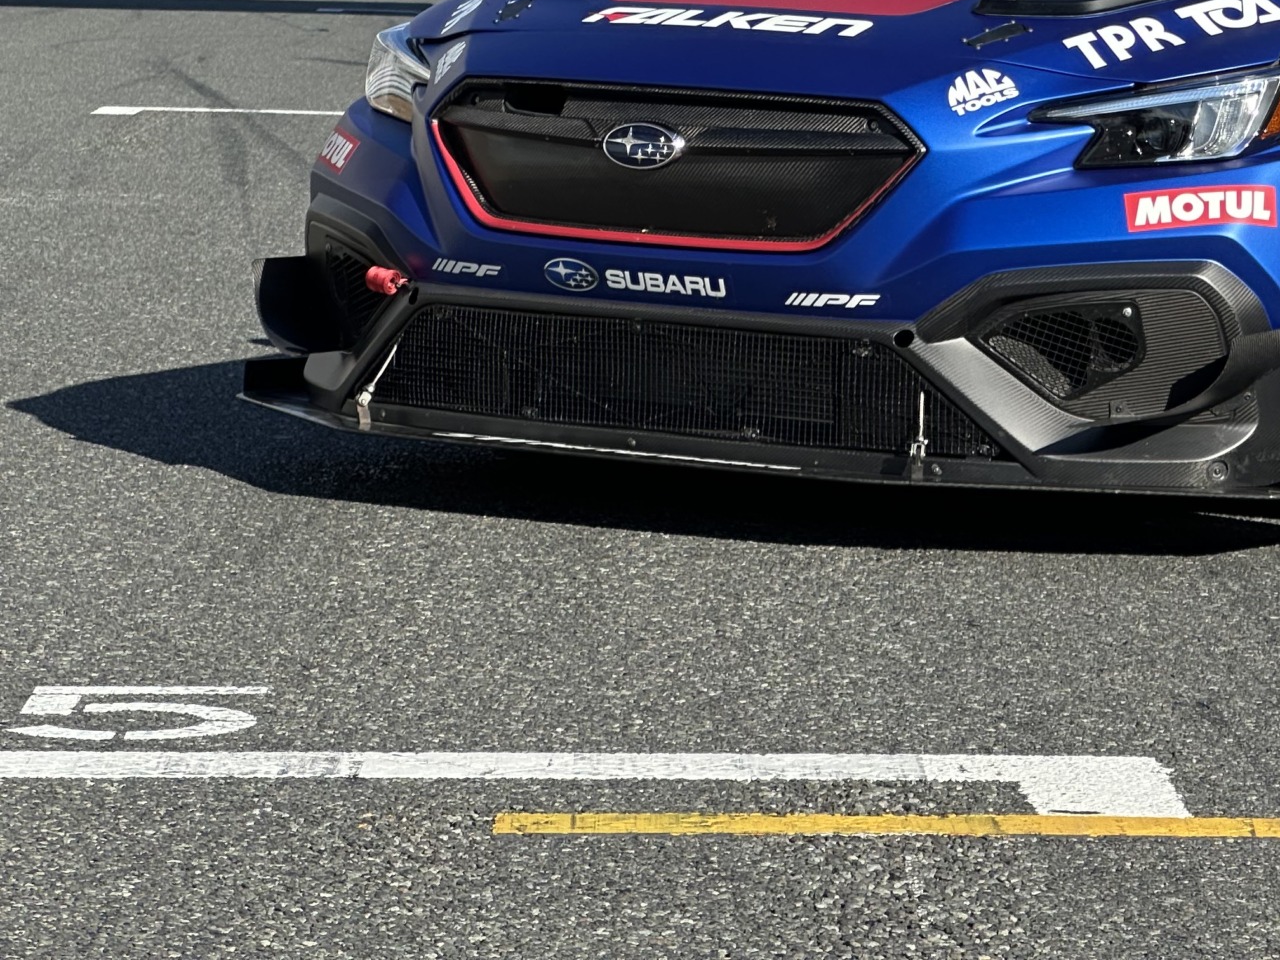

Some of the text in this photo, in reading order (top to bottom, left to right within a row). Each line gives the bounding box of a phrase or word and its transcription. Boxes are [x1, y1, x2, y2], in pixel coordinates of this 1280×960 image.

[582, 6, 873, 37] FALKEN
[1063, 17, 1186, 70] TPR
[948, 69, 1016, 107] MAC
[952, 88, 1019, 116] TOOLS
[321, 131, 354, 168] OTUL
[1134, 191, 1271, 226] MOTUL
[605, 269, 727, 298] SUBARU
[2, 685, 272, 740] 5
